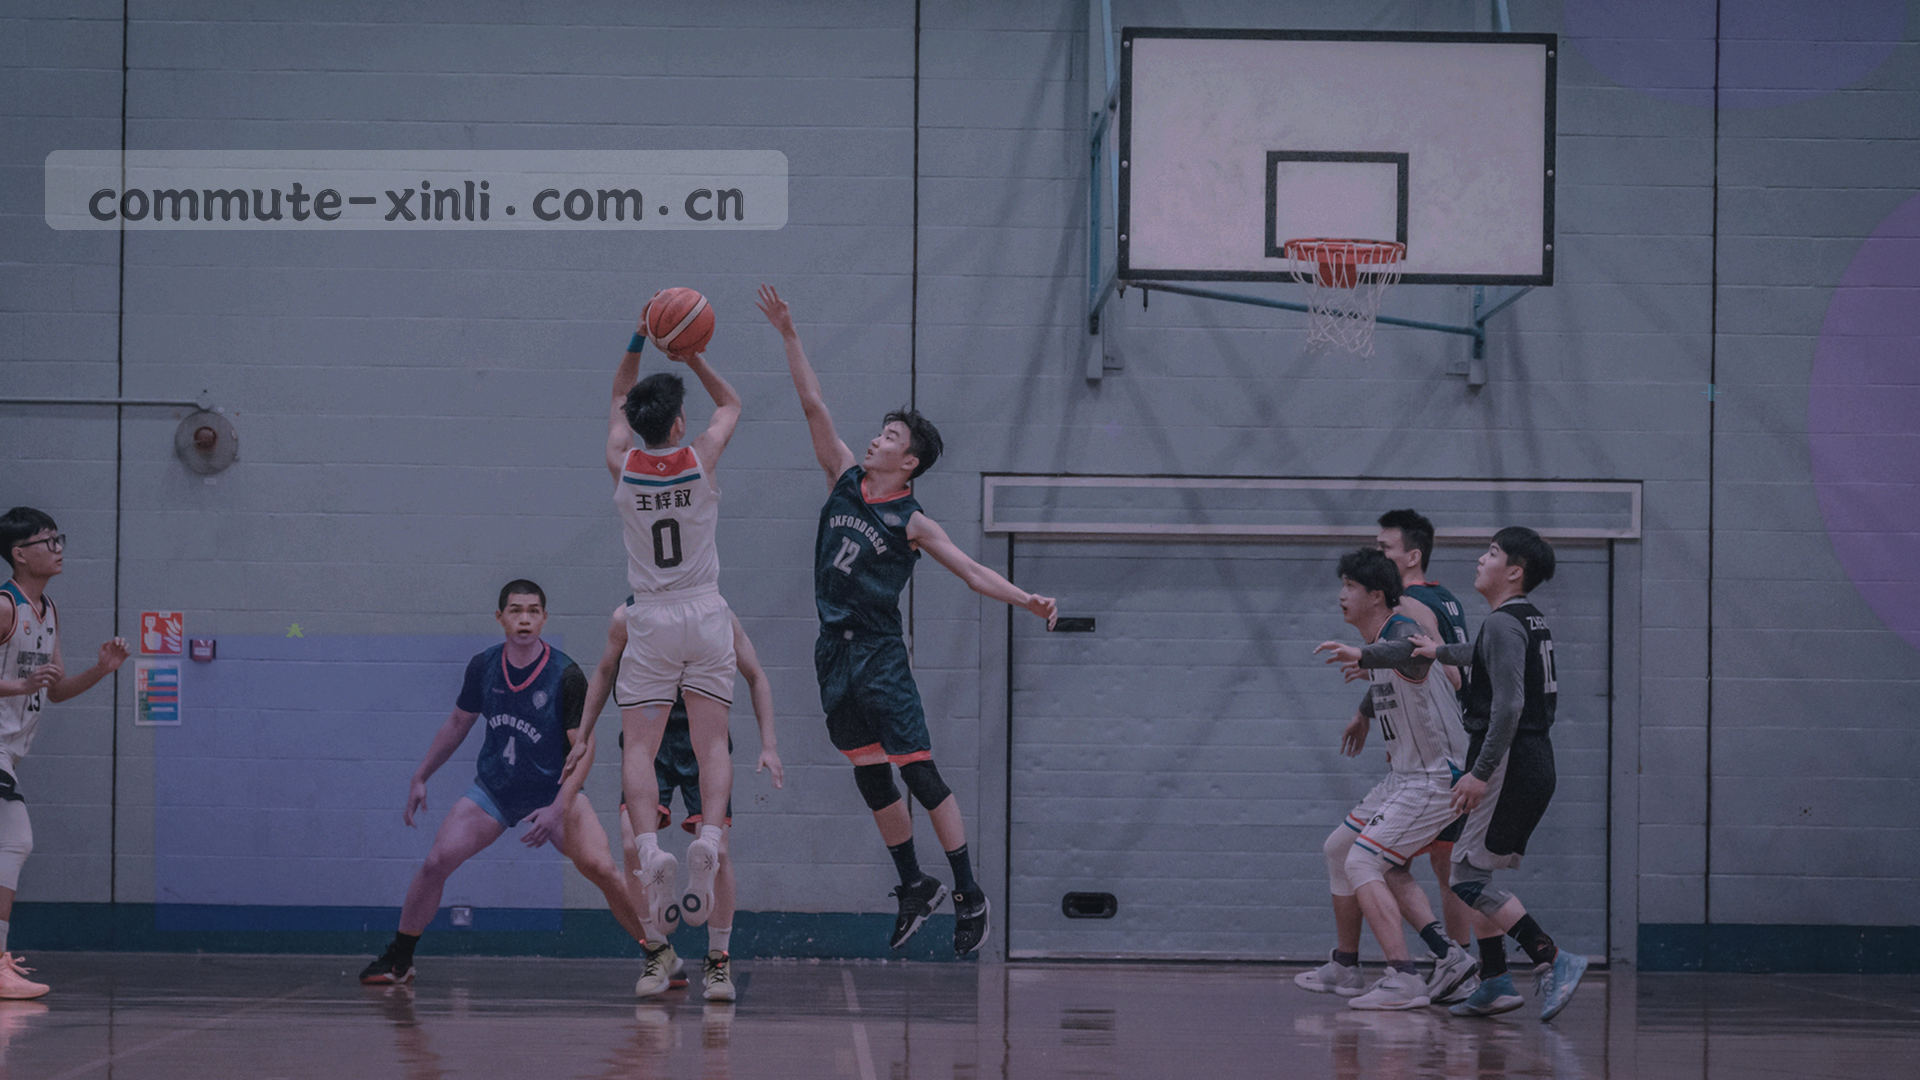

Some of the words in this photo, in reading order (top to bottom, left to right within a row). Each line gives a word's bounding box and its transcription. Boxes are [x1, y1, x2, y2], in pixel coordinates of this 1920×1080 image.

[651, 517, 683, 569] 0
[833, 536, 861, 575] 12
[1380, 714, 1396, 741] 11
[503, 736, 516, 766] 4
